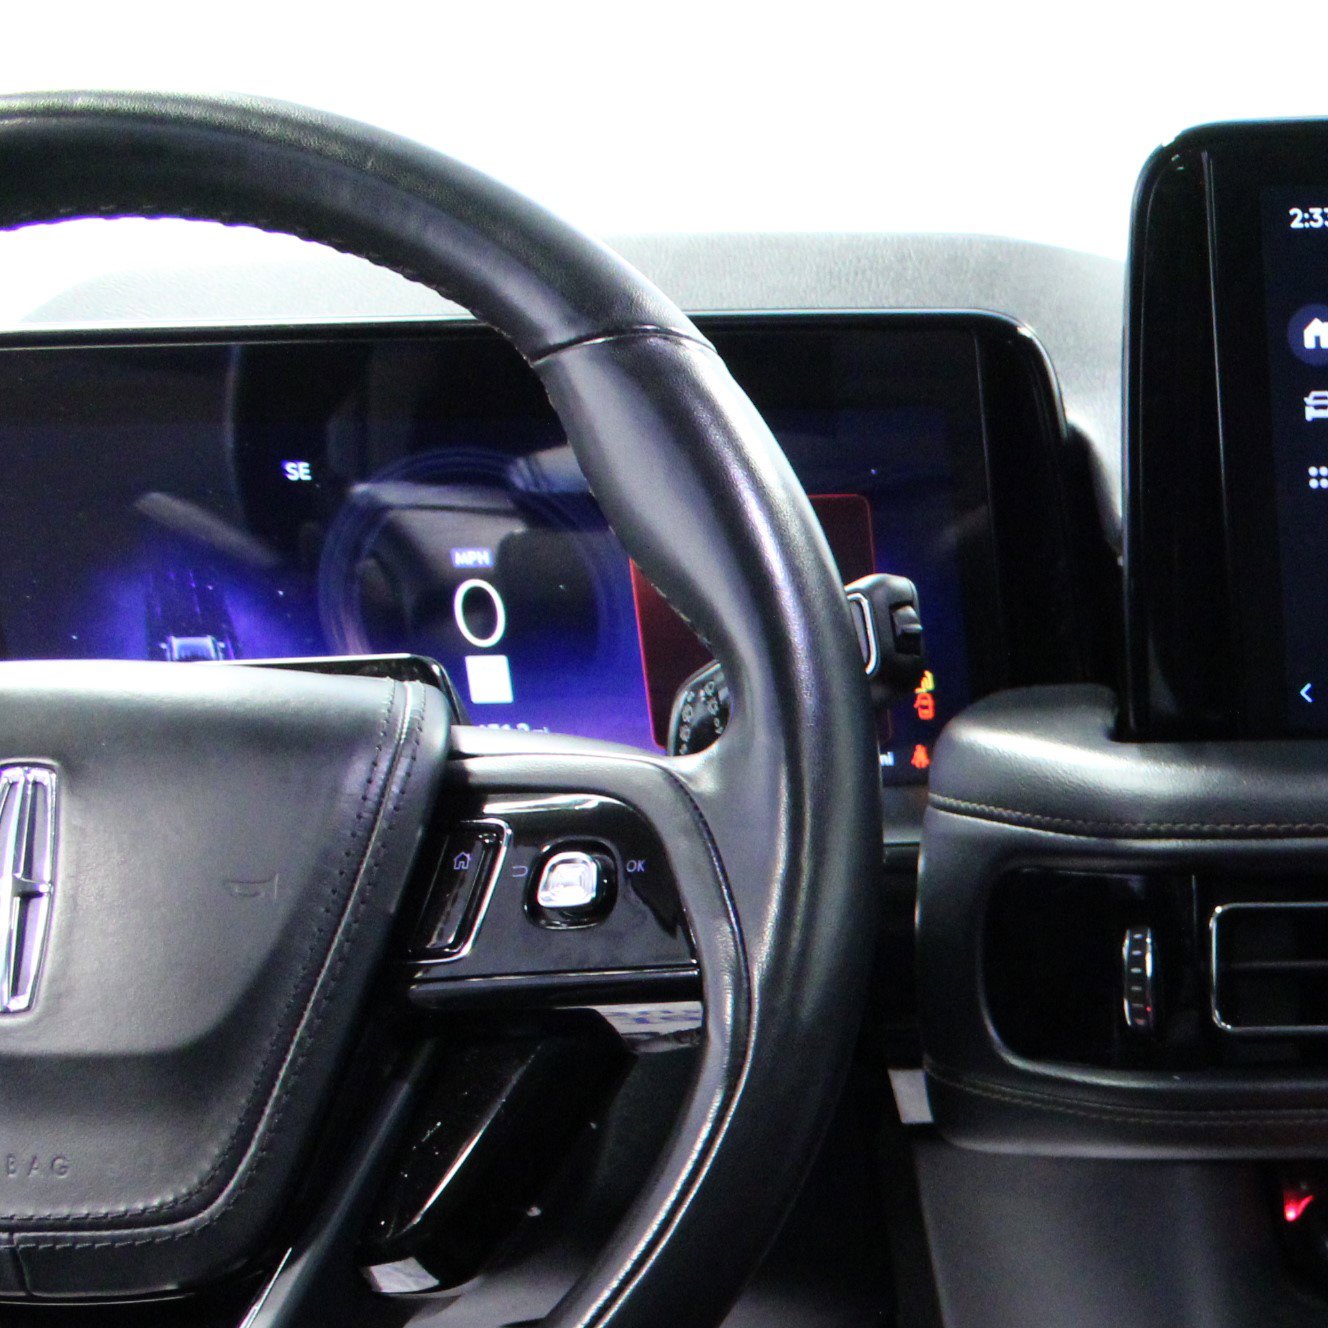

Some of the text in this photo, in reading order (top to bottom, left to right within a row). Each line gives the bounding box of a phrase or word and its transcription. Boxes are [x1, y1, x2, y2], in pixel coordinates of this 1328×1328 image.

[281, 460, 312, 481] SE
[451, 546, 494, 568] MPH
[453, 578, 506, 648] 0
[626, 859, 647, 874] OK
